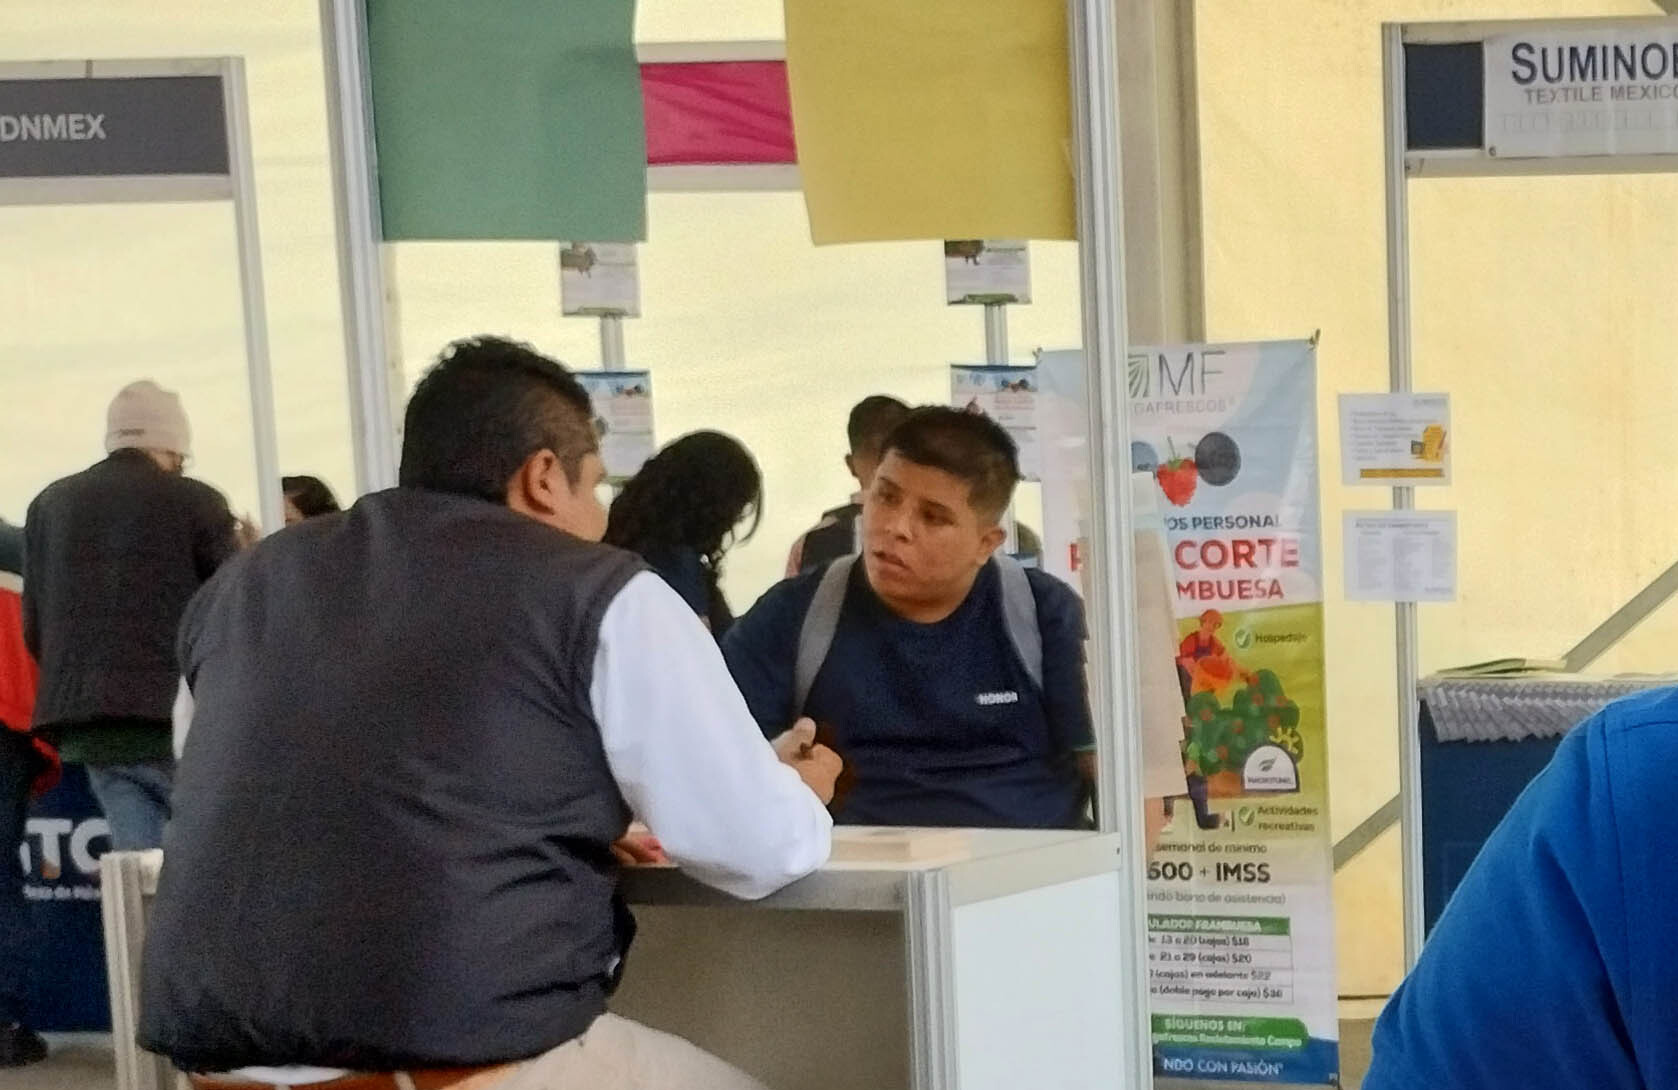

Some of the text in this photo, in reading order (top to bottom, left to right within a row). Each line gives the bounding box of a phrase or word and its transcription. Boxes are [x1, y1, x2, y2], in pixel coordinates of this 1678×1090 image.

[1525, 87, 1603, 104] TEXTILE
[0, 114, 106, 142] DNMEX
[1158, 351, 1226, 396] MF
[1174, 538, 1299, 570] CORTE
[1176, 579, 1284, 600] MBUESA
[1258, 805, 1319, 816] Actividades
[1258, 821, 1315, 832] recreativas
[1216, 862, 1271, 884] IMSS
[1197, 1058, 1229, 1073] CON
